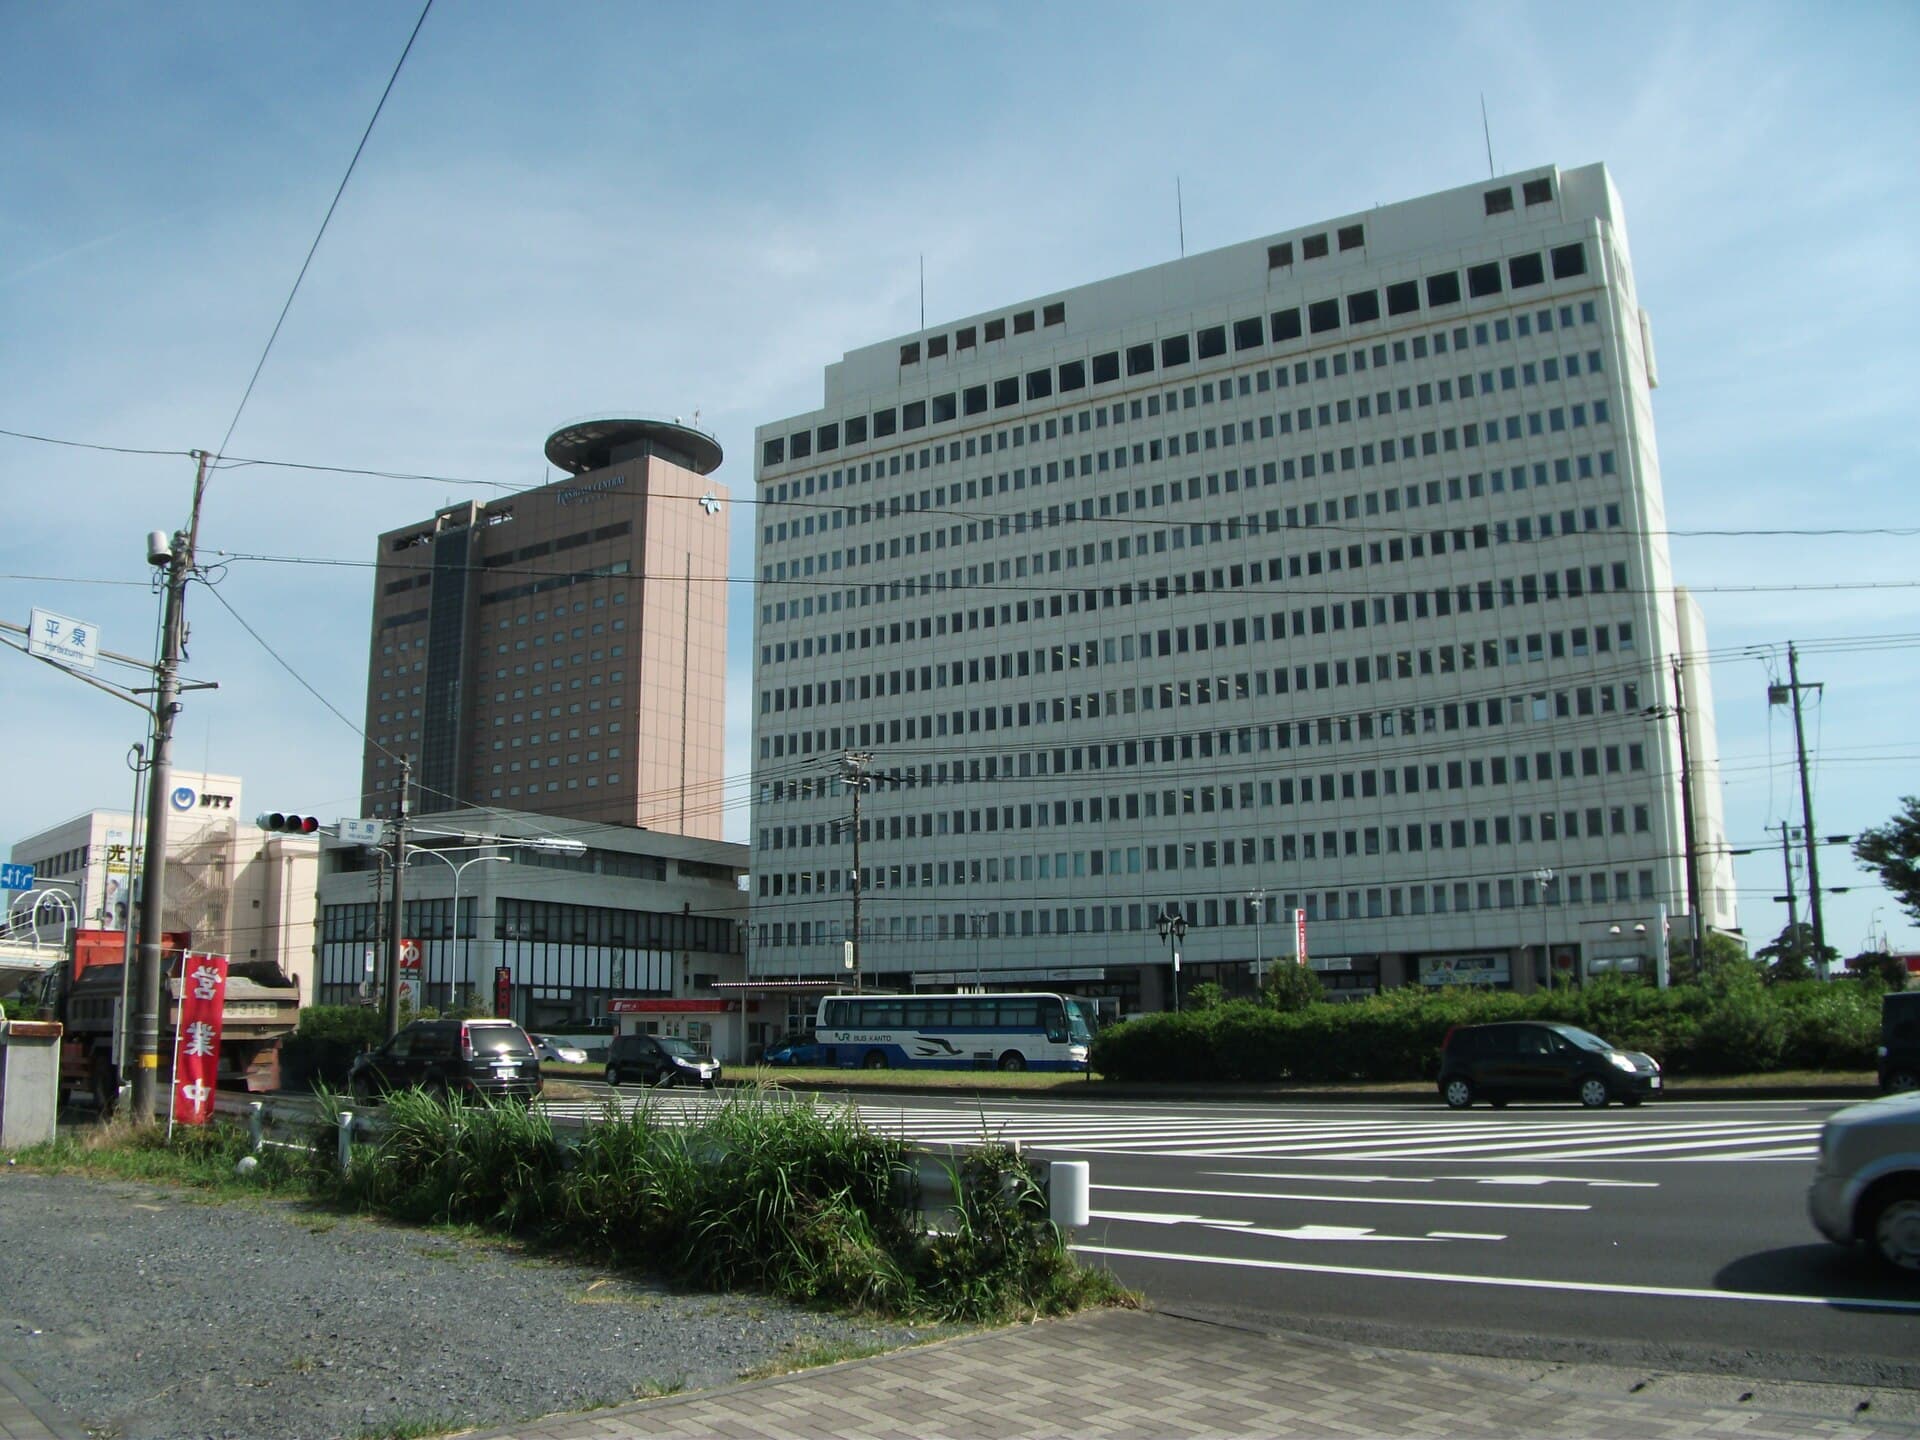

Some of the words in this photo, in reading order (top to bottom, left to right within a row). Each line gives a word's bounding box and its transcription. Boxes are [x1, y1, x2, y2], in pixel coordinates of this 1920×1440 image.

[45, 619, 86, 647] 平泉
[200, 793, 233, 809] NTT
[183, 965, 222, 1115] 営業中
[838, 1032, 850, 1041] JR
